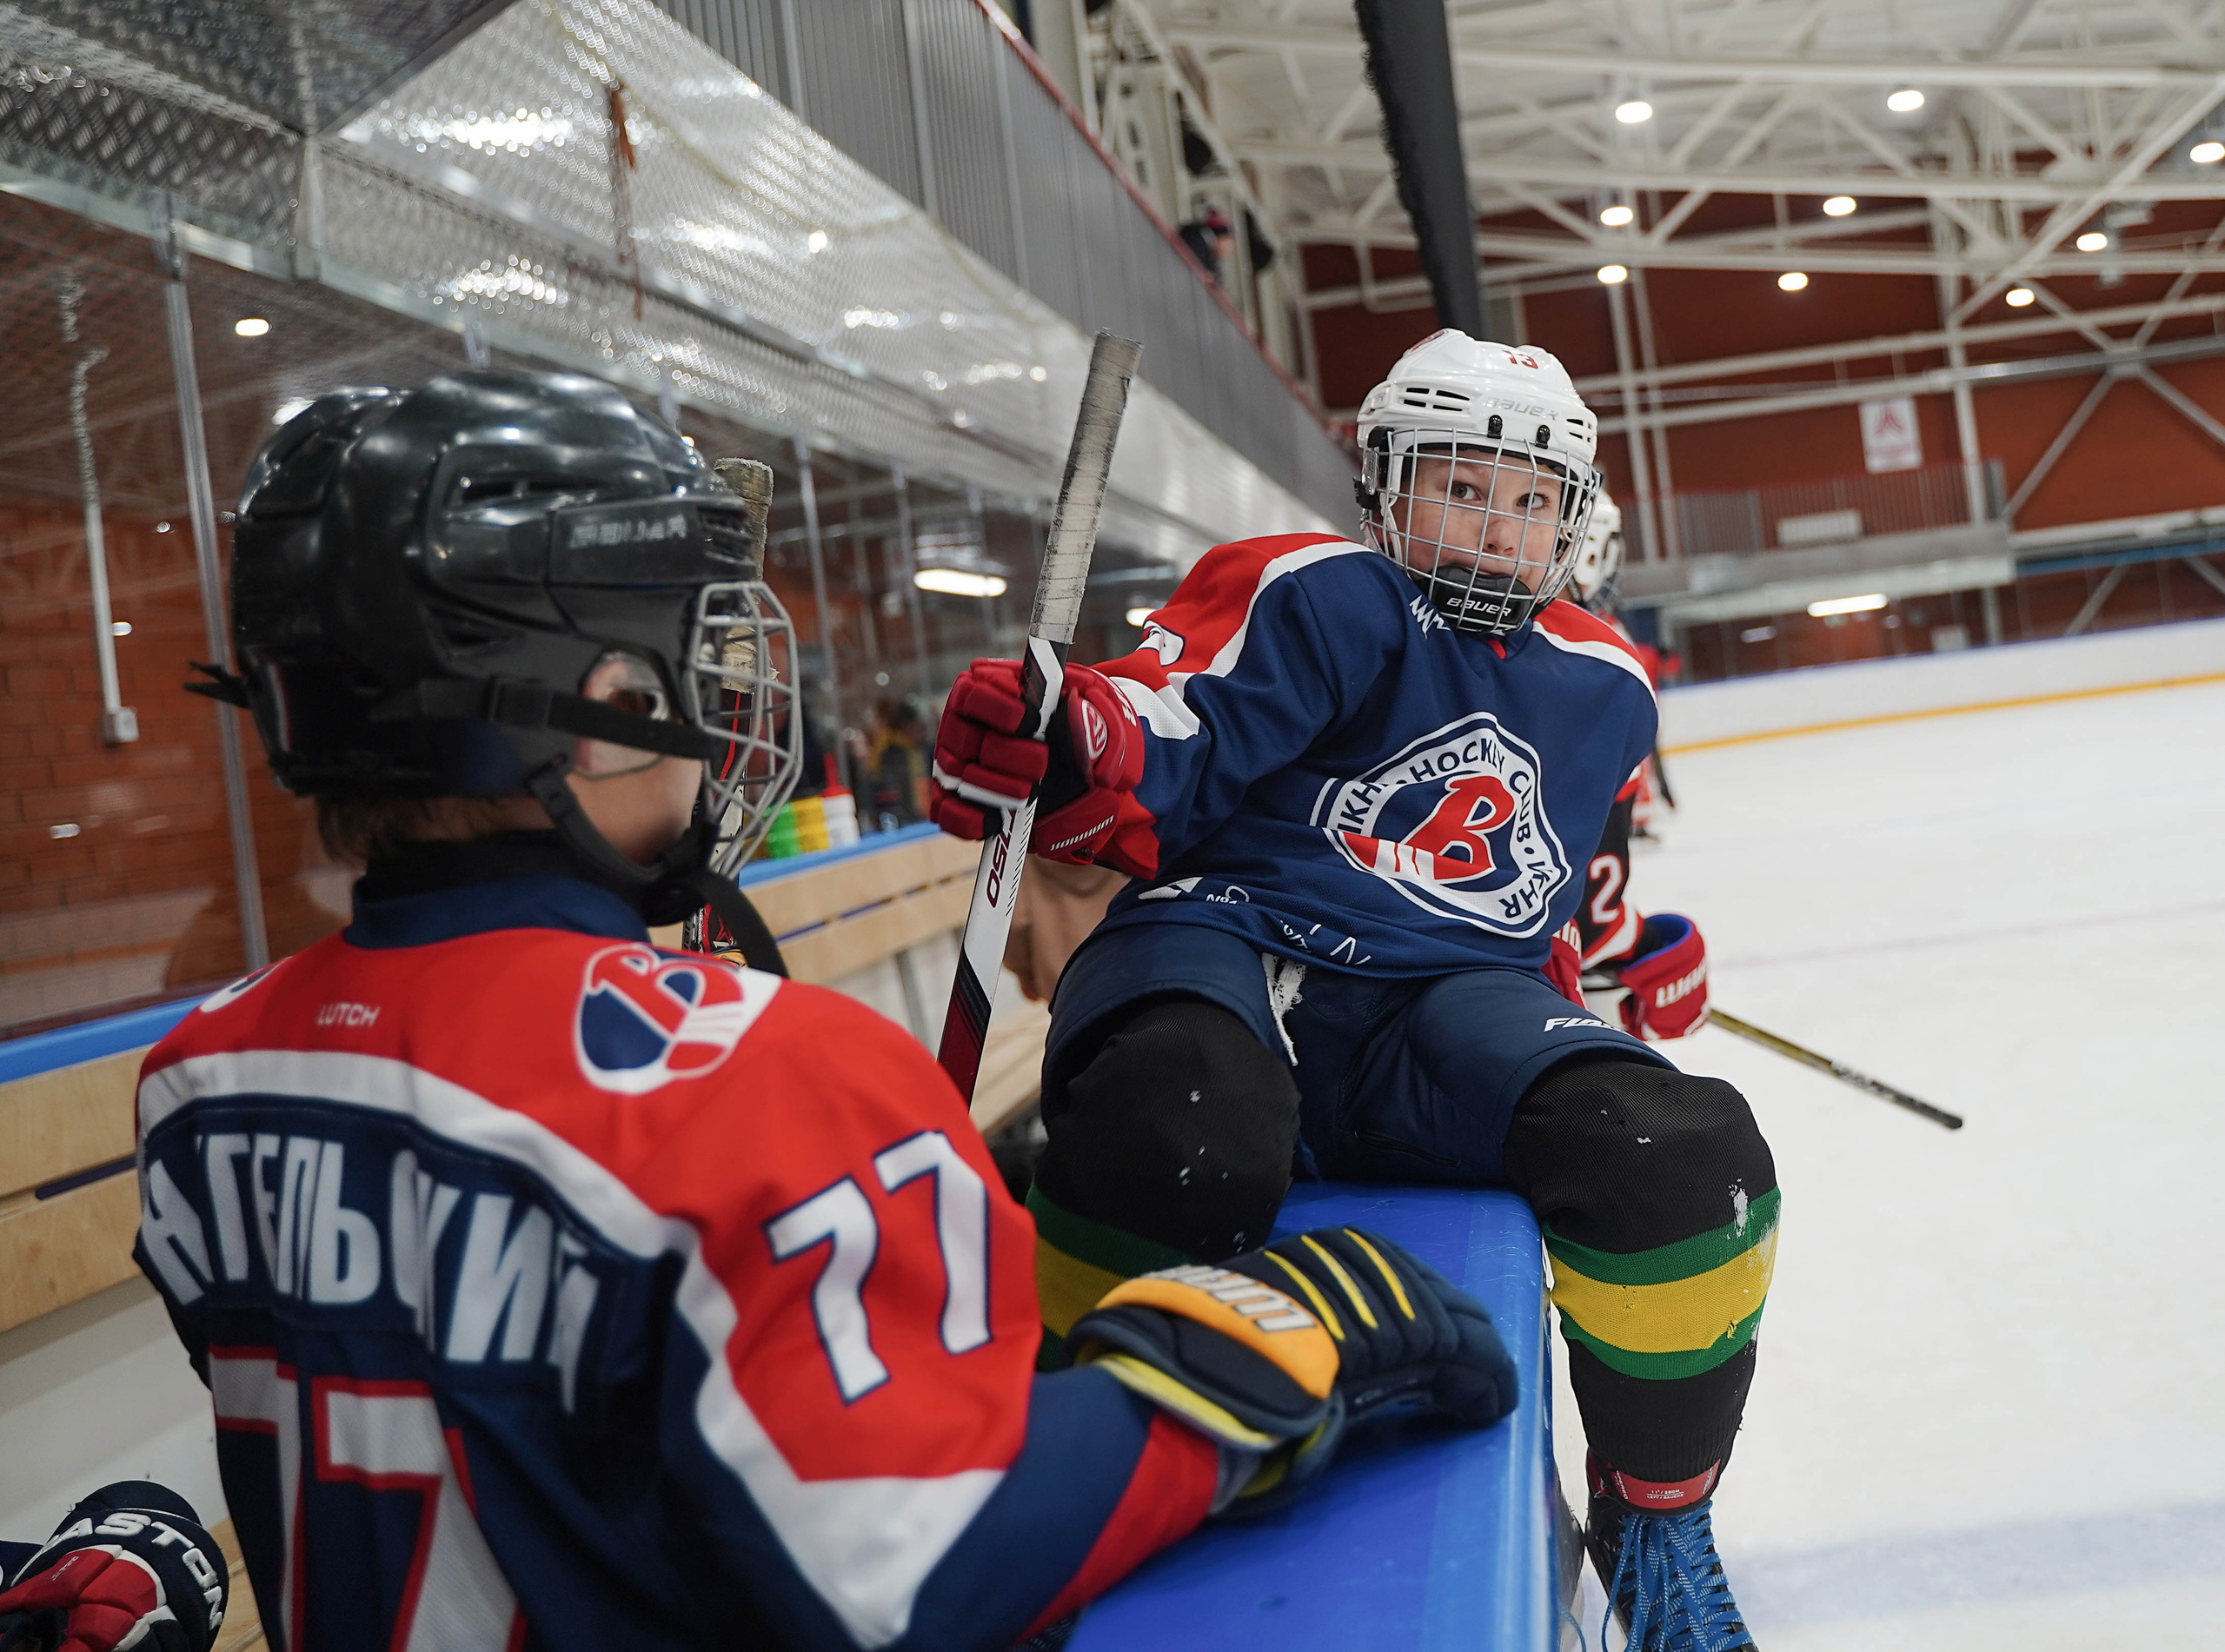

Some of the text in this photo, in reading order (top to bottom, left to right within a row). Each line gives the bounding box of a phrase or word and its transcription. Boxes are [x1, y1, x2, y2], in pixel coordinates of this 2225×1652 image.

[1502, 349, 1538, 369] 13
[1485, 395, 1559, 421] BAUER
[1446, 597, 1512, 617] BAUER
[316, 1003, 382, 1026] LUTCH
[761, 1130, 995, 1406] 77
